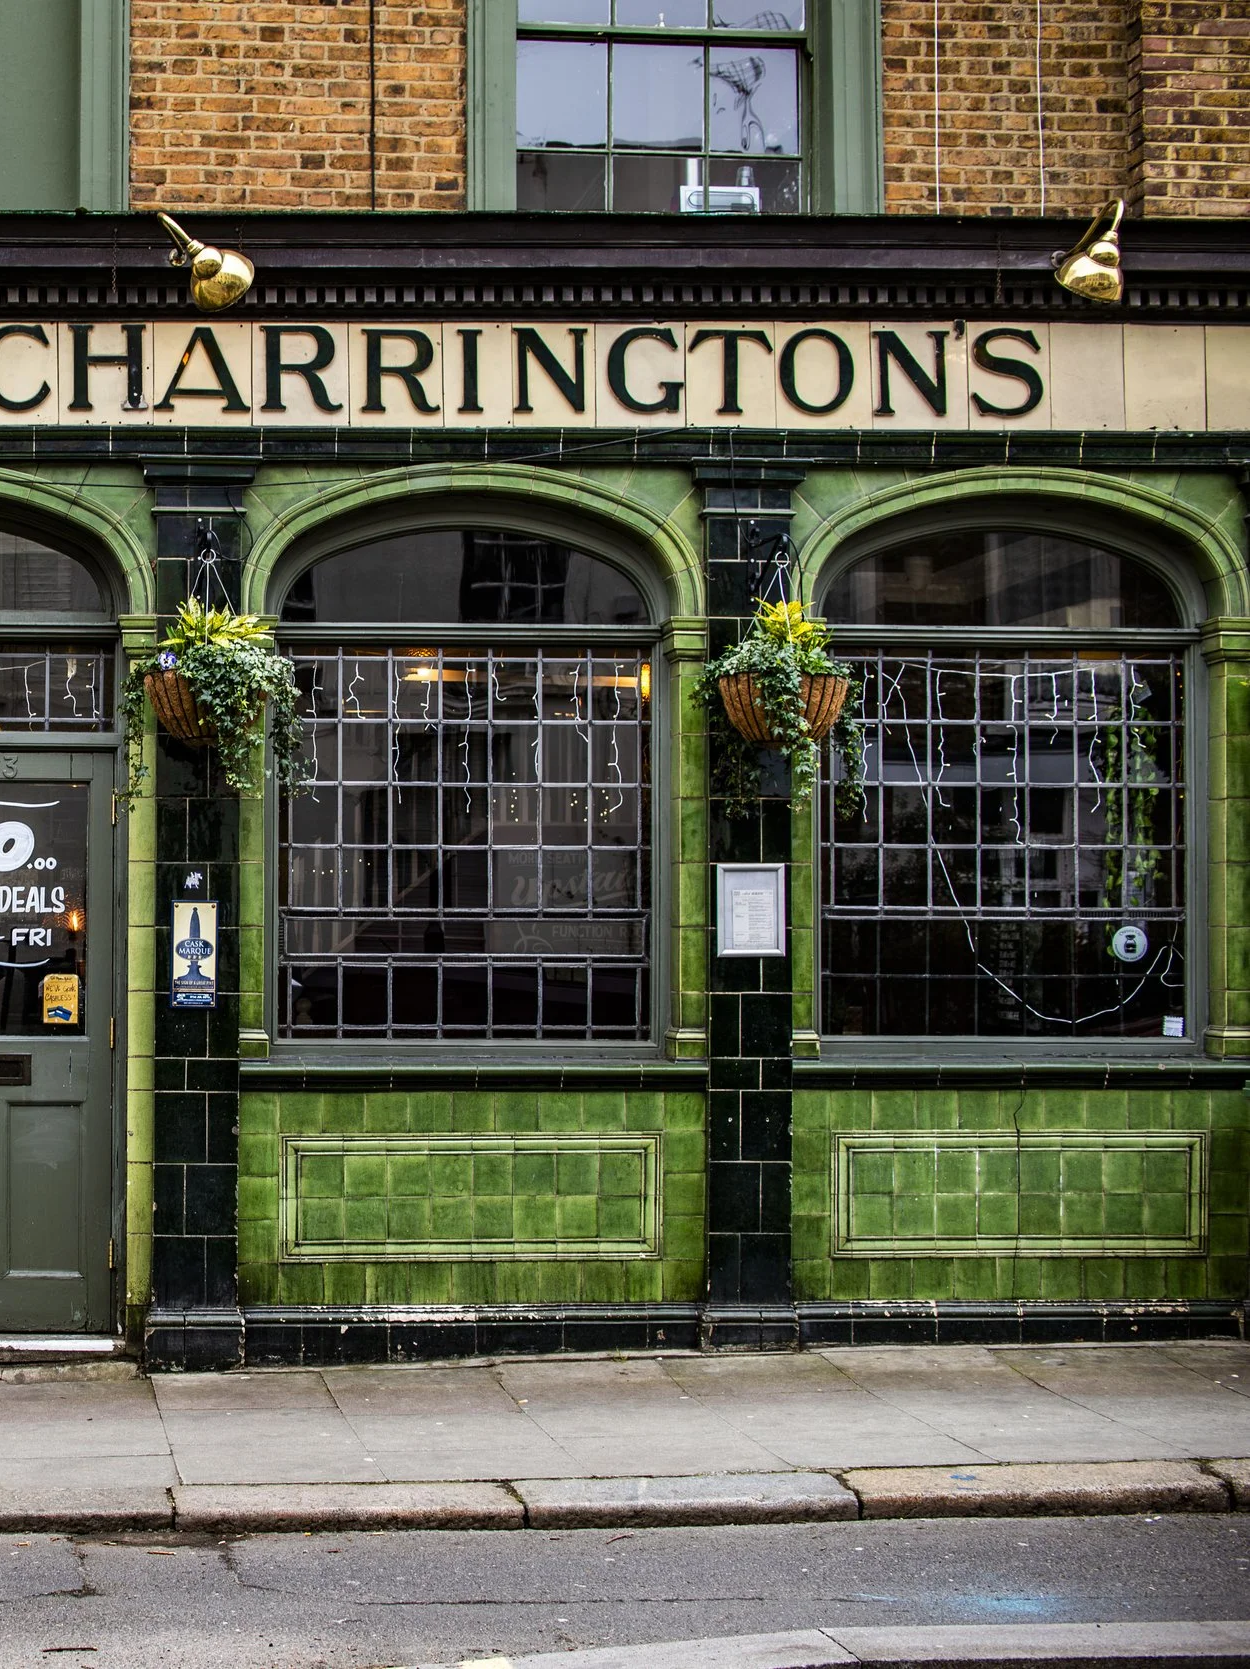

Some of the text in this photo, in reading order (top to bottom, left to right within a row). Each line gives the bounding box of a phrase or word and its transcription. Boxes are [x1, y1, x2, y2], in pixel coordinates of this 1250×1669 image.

[508, 852, 599, 865] MOR SEATIG
[11, 928, 52, 946] FRI
[552, 925, 613, 938] FUNCTION
[178, 947, 212, 955] MARQUE
